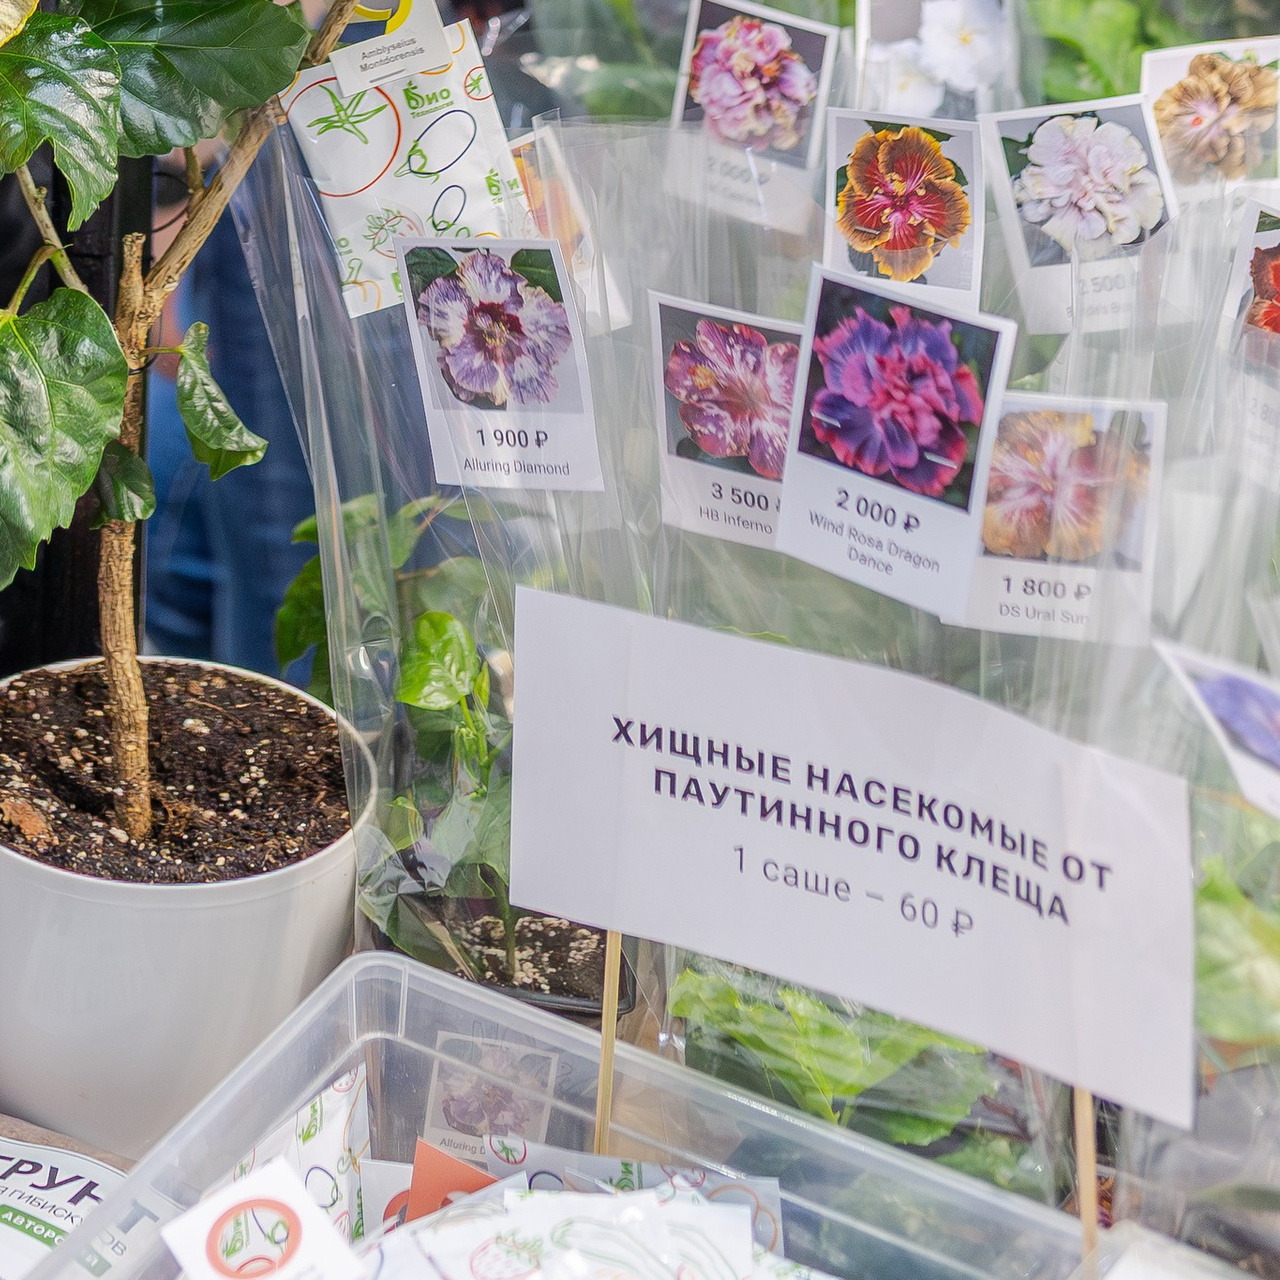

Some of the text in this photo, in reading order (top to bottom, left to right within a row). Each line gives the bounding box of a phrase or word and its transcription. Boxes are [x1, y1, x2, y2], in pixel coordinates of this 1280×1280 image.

[360, 47, 425, 72] Montdorensis
[361, 38, 417, 60] Amblyseius
[476, 429, 485, 446] 1
[494, 429, 528, 448] 900
[463, 457, 570, 475] Alluring Diamond
[711, 482, 723, 500] 3
[731, 488, 769, 511] 500
[835, 489, 849, 511] 2
[856, 497, 897, 527] 000
[699, 505, 773, 534] HB Inferno
[809, 510, 940, 574] Wind Rosa Dragon
[847, 546, 893, 575] Dance
[1002, 575, 1011, 594] 1
[1023, 579, 1066, 599] 800
[1000, 604, 1021, 617] DS
[1025, 607, 1055, 621] Ural
[612, 716, 1113, 892] ХИЩНЫЕ НАСЕКОМЫЕ ОТ
[653, 768, 1070, 926] ПАУТИННОГО КЛЕЩА
[733, 845, 745, 873] 1
[763, 858, 851, 901] саше
[900, 893, 939, 928] 60
[440, 1138, 477, 1155] Alluring
